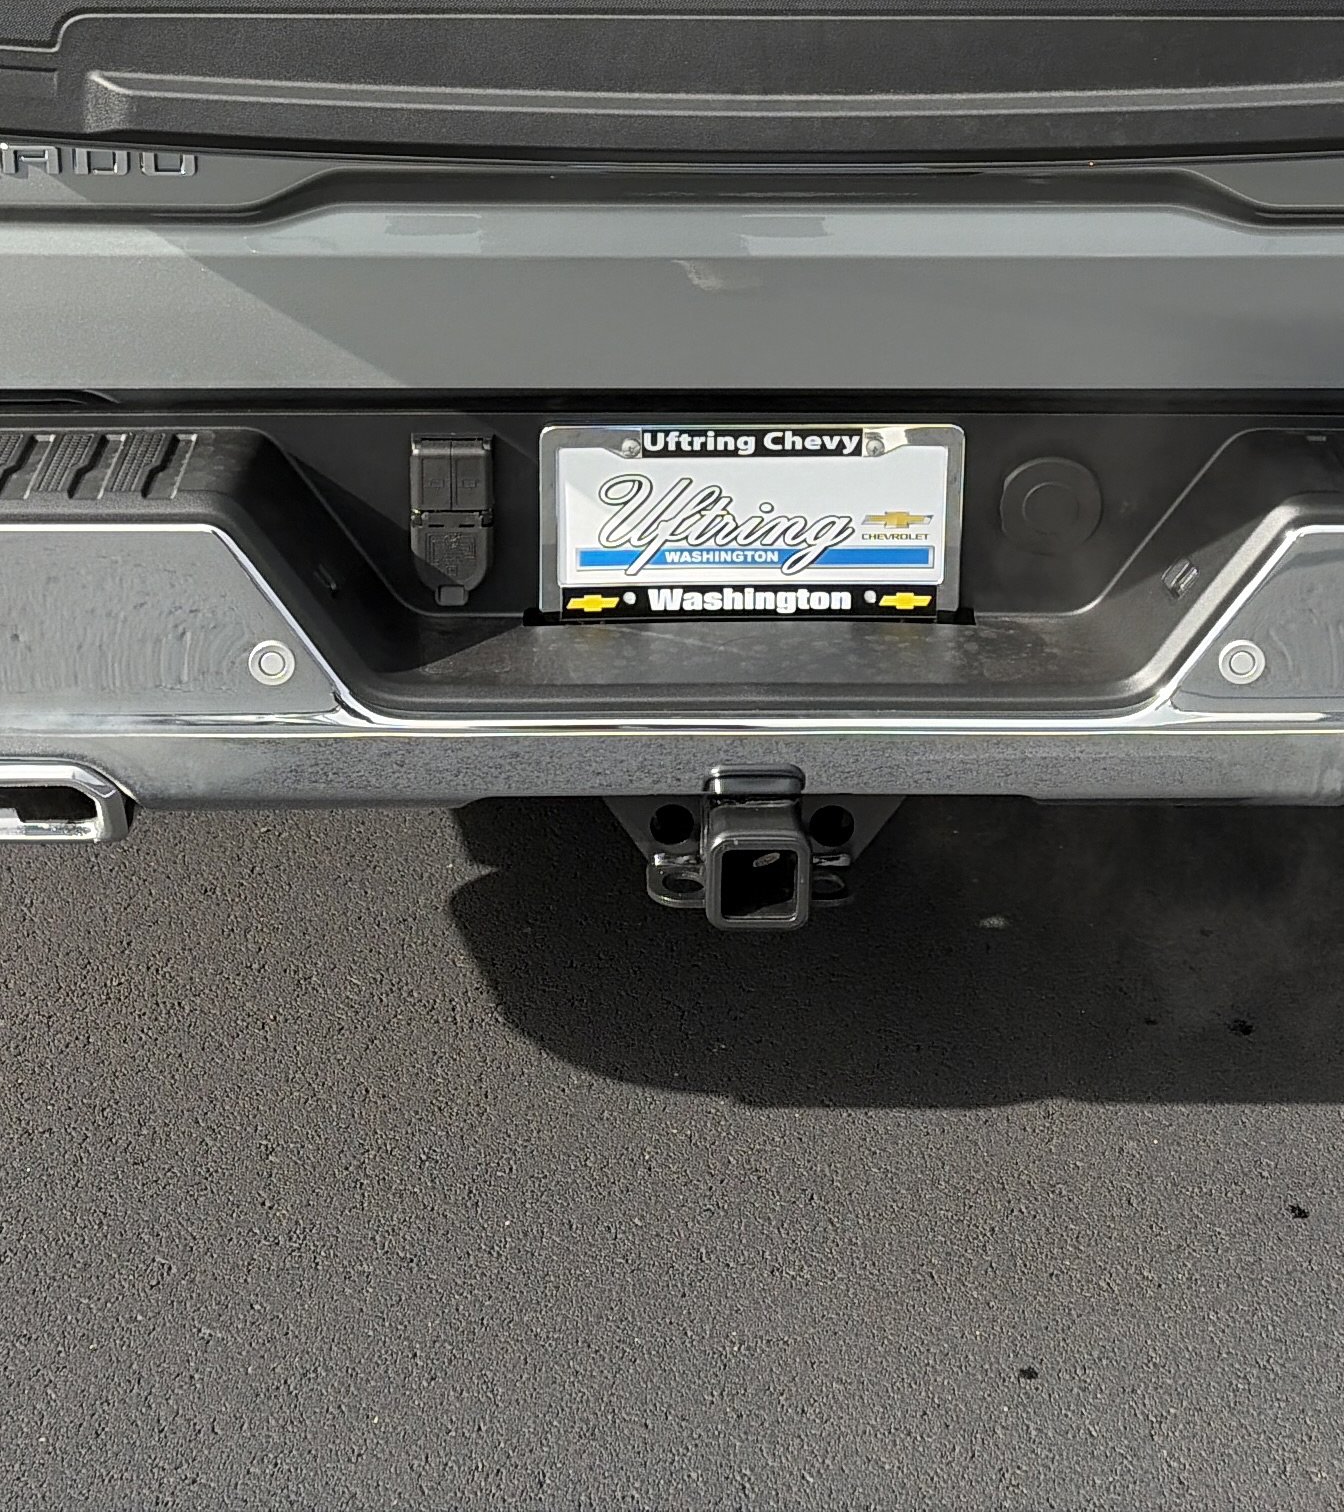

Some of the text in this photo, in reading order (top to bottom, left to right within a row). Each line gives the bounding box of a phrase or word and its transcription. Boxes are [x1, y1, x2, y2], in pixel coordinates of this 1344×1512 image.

[643, 431, 861, 455] Uftring Chevy
[598, 473, 856, 576] Uftring
[861, 532, 930, 541] CHEVROLET
[664, 549, 780, 564] WASHINGTON
[647, 588, 852, 614] Washington
